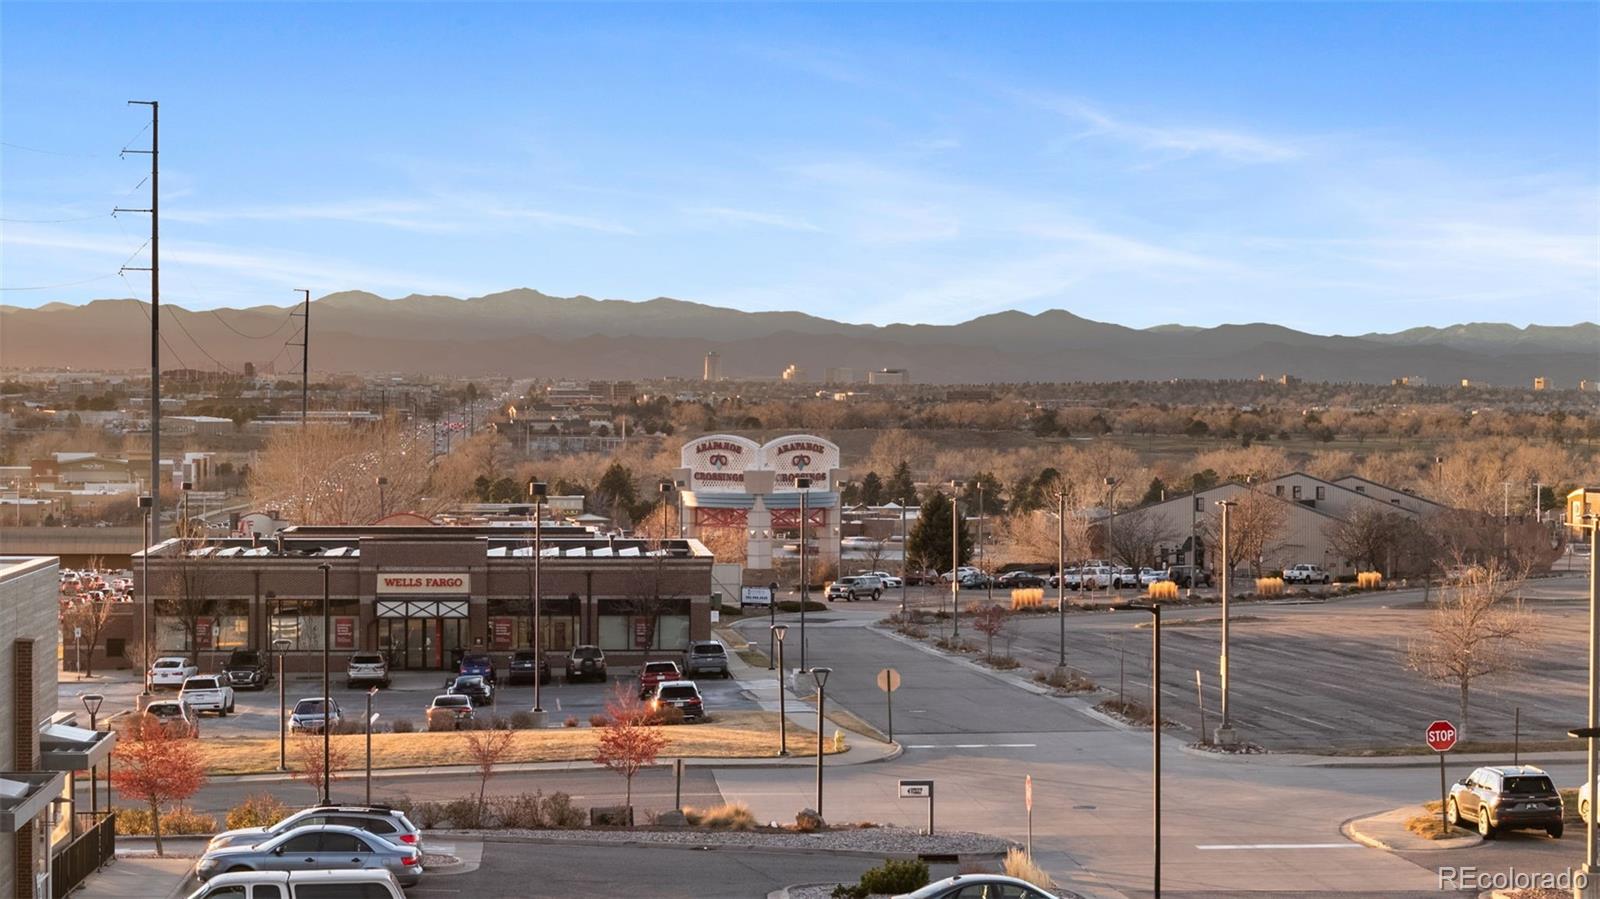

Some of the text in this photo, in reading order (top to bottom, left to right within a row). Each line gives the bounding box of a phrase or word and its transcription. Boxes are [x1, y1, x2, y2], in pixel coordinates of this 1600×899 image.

[696, 442, 742, 454] ARAPAHOE
[777, 442, 825, 456] ARAPAHOE
[694, 472, 744, 482] CROSSINGS
[384, 578, 463, 587] WELLS FARGO
[1429, 730, 1454, 742] STOP
